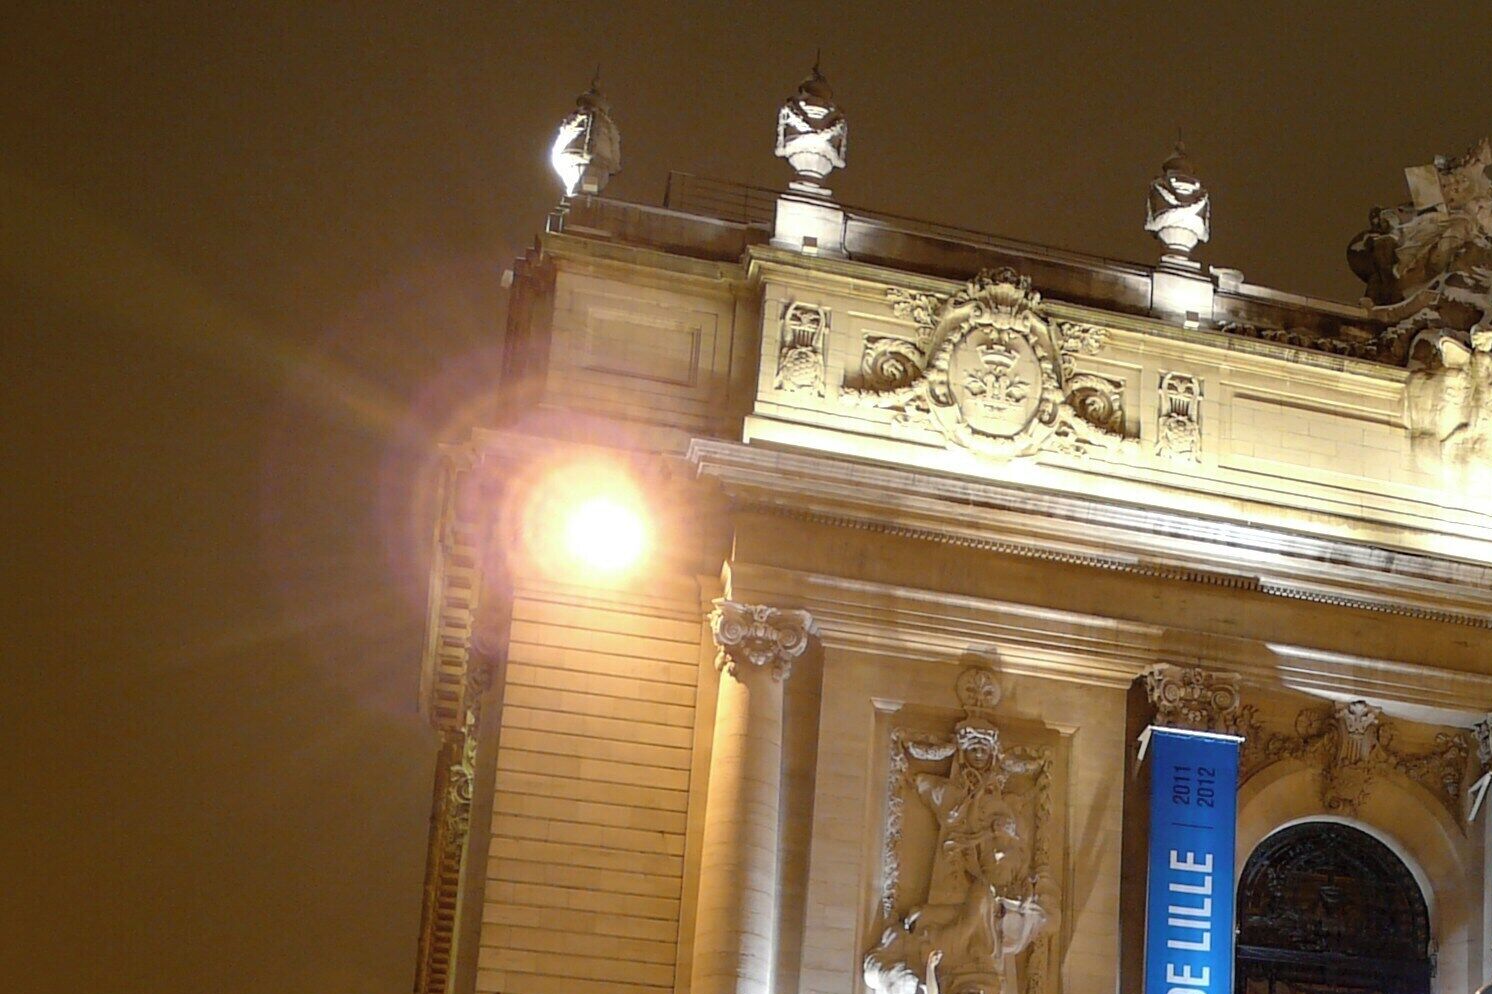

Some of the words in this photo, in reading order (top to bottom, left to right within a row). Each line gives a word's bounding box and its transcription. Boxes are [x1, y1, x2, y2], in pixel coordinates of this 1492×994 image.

[1172, 765, 1190, 806] 2011
[1196, 766, 1216, 808] 2012
[1167, 849, 1213, 952] LILLE
